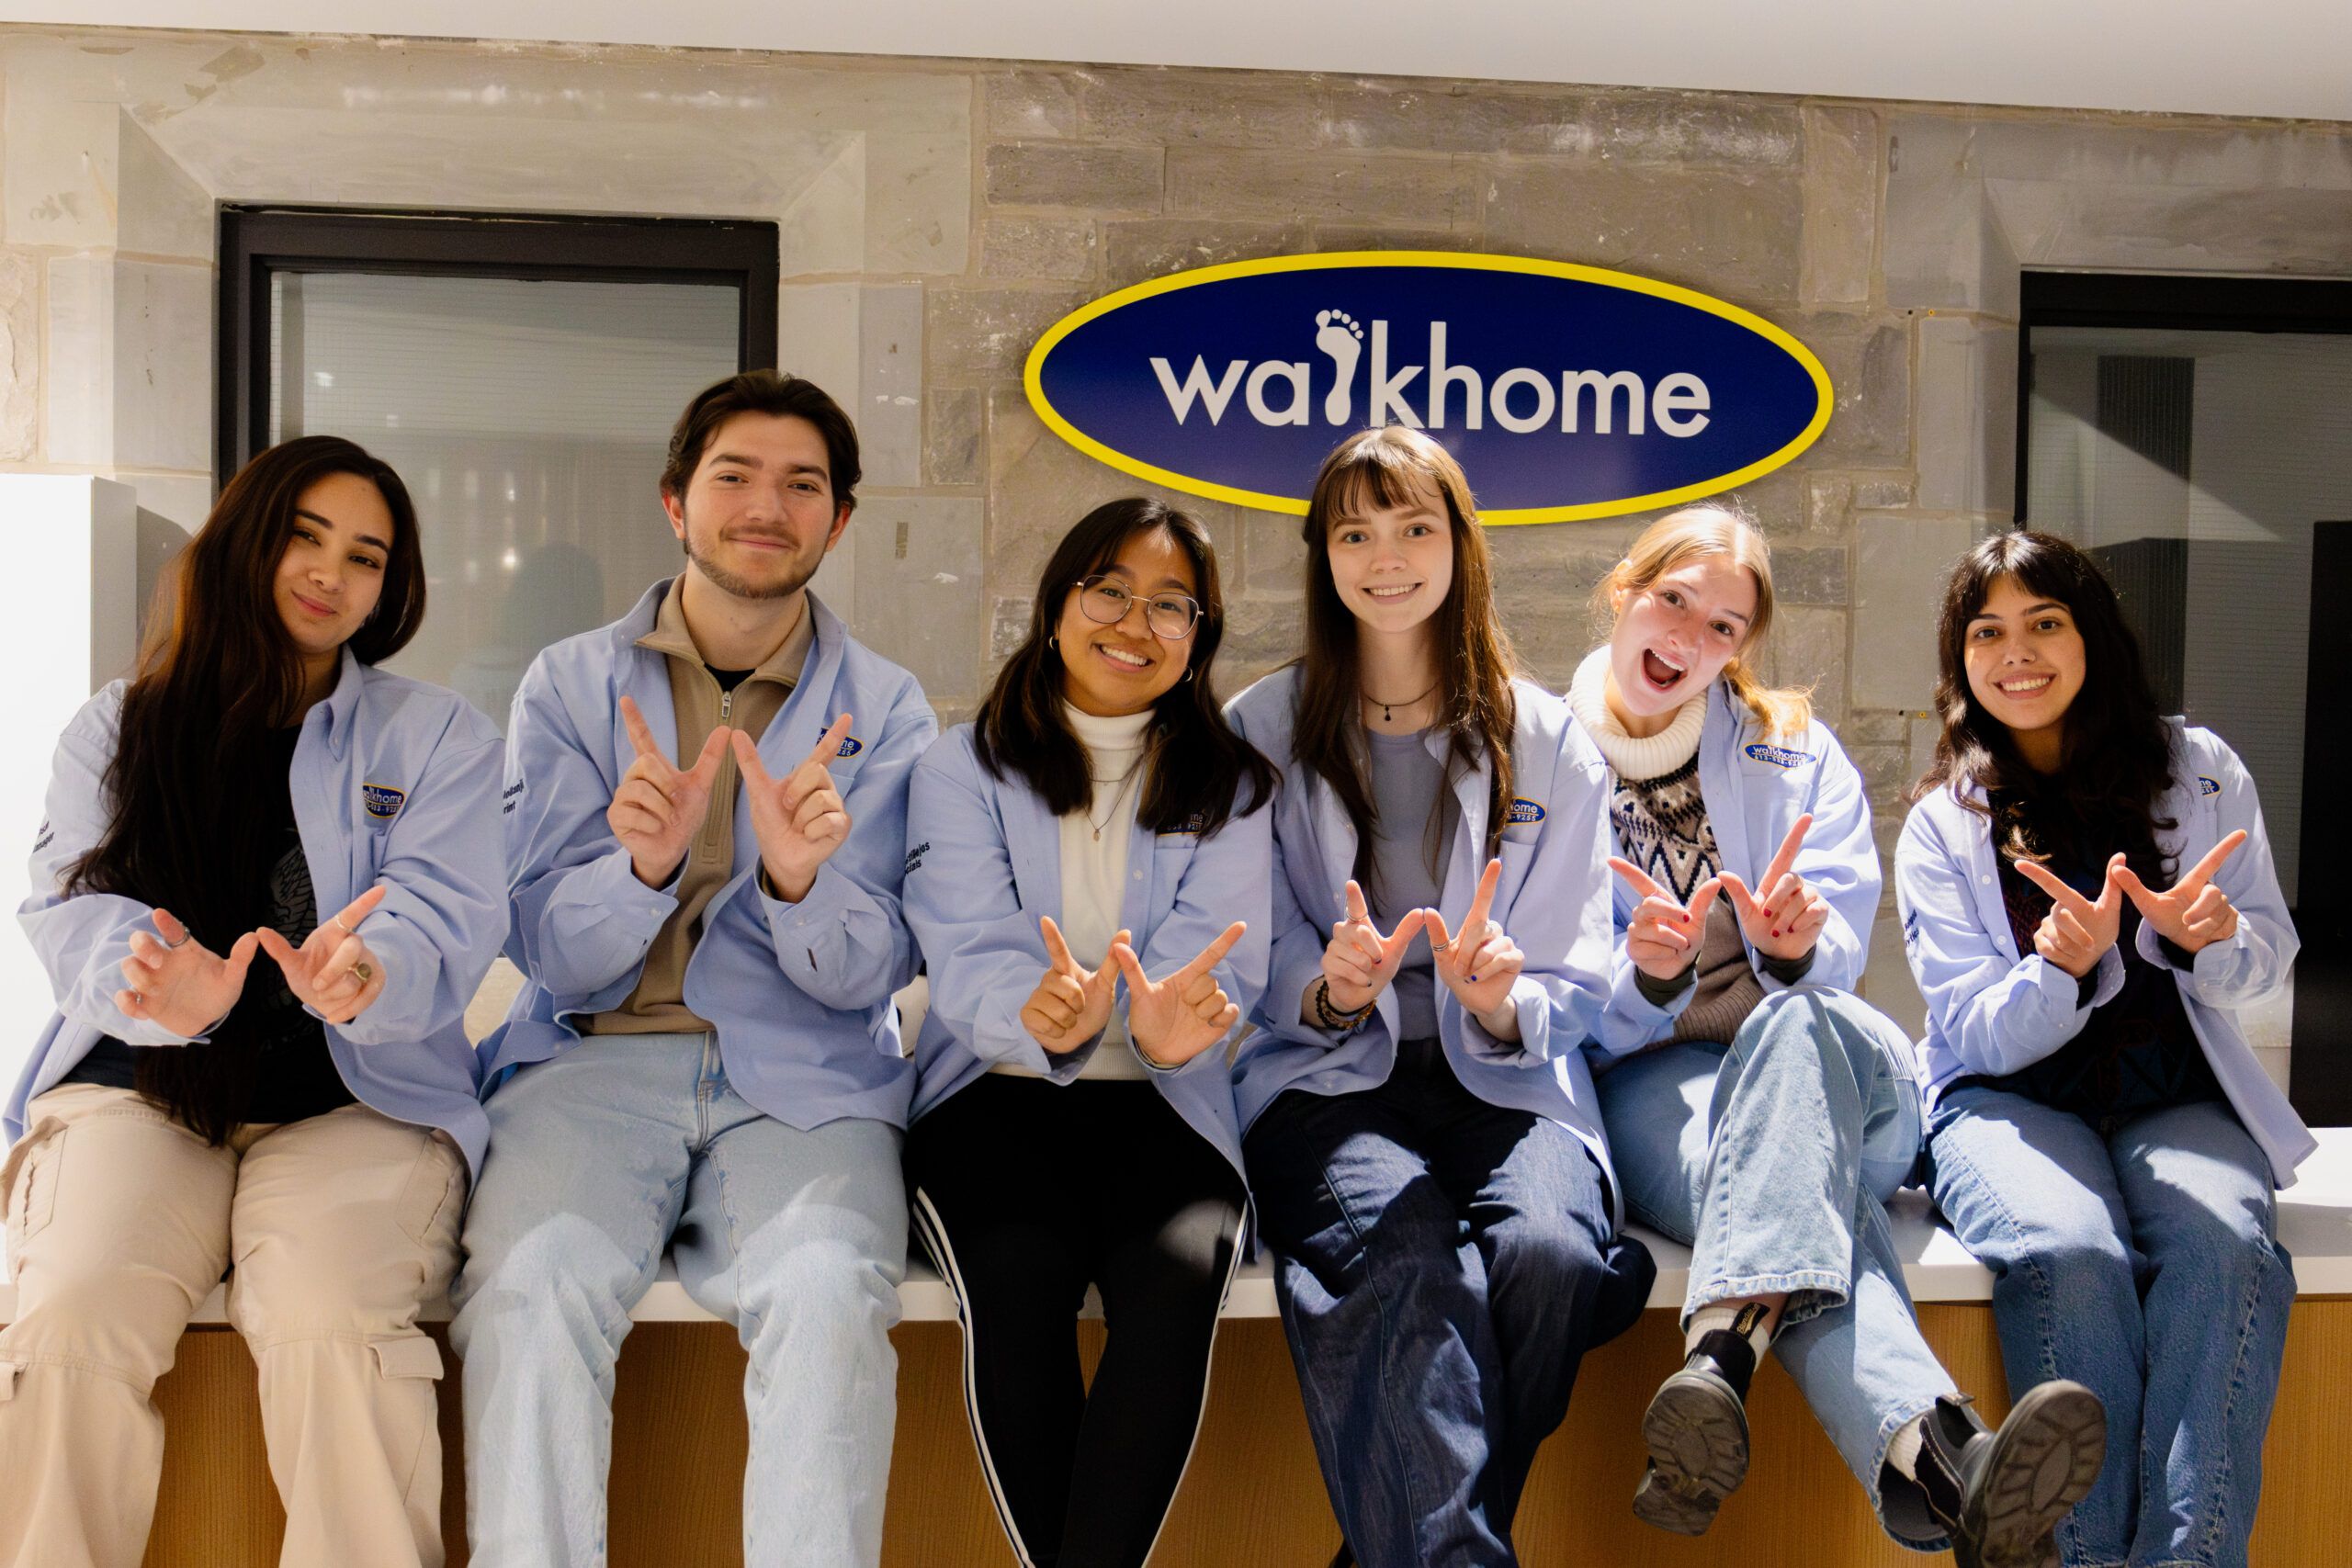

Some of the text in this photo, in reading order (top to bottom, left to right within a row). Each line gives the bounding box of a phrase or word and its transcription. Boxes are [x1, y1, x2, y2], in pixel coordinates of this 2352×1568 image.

[1149, 309, 1711, 438] walkhome
[1753, 745, 1806, 761] walkhome
[363, 786, 402, 803] alkhome
